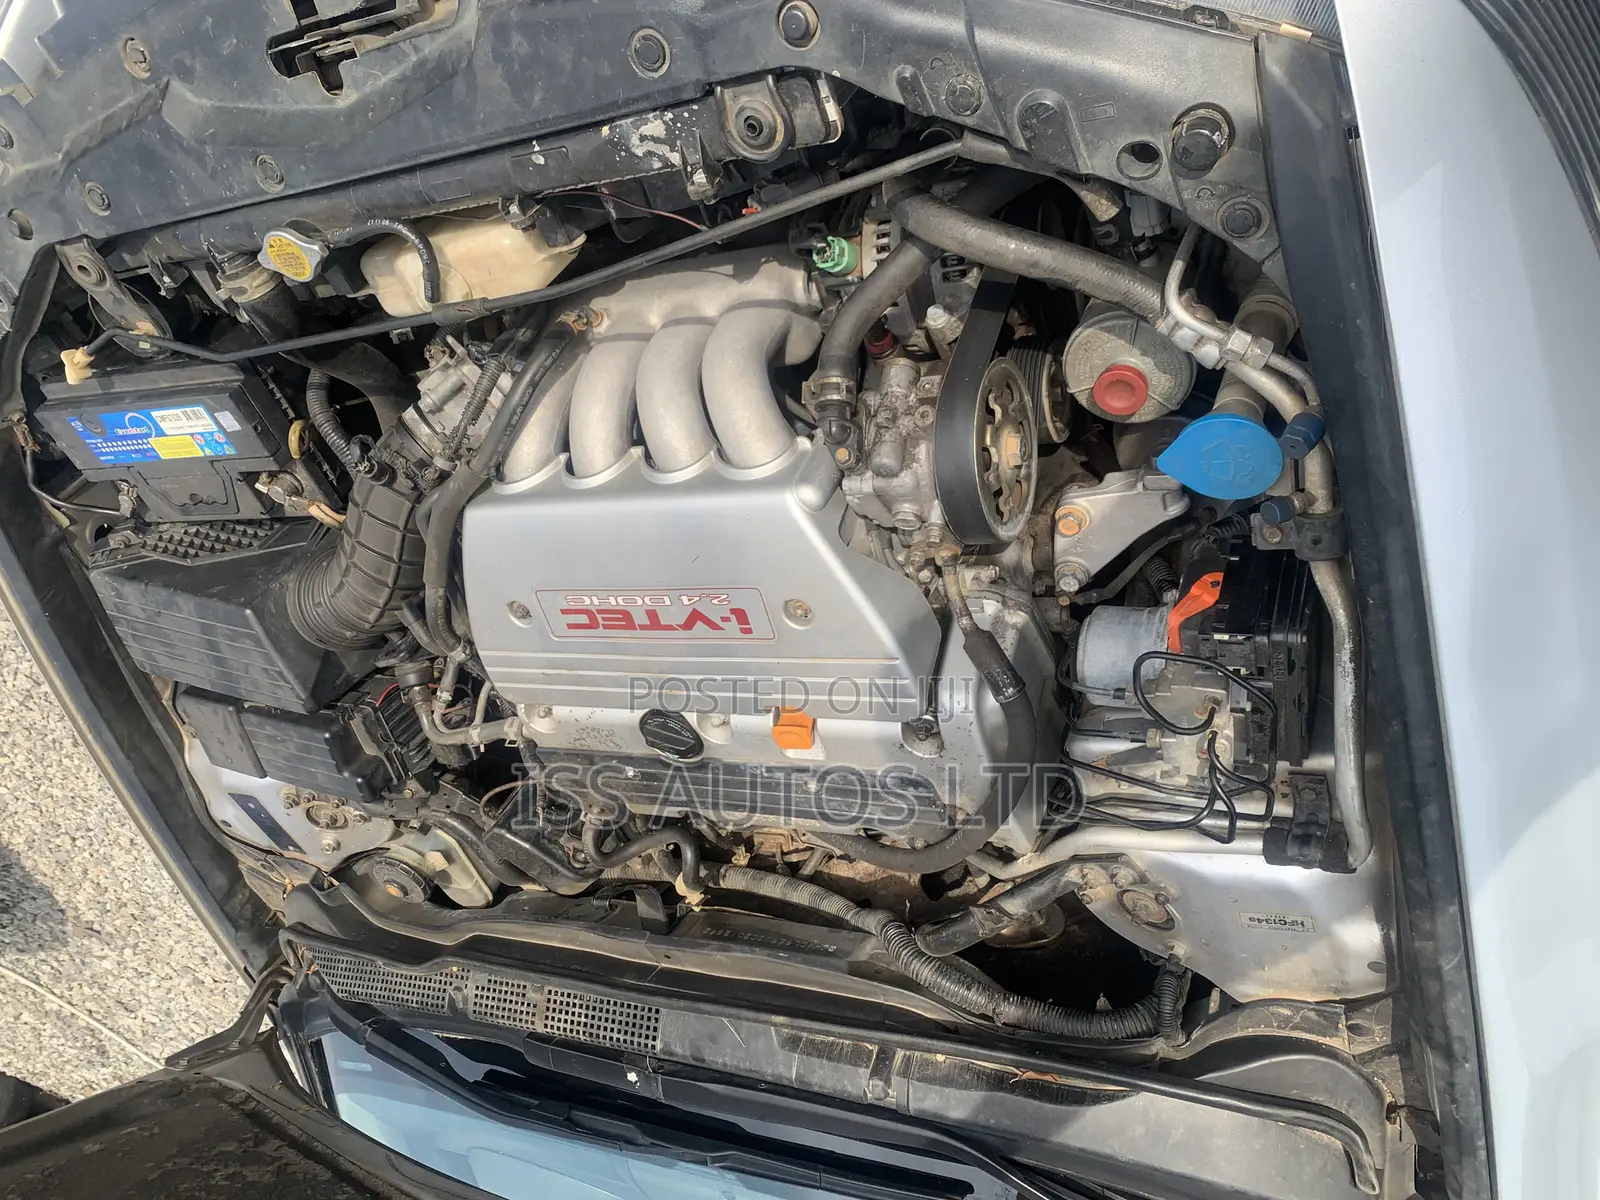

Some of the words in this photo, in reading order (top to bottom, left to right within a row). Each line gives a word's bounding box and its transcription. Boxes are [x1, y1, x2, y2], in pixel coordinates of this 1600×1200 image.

[564, 594, 673, 607] DOHC
[678, 592, 732, 606] 2.4
[559, 607, 754, 635] i-VTEC
[1248, 917, 1304, 927] HFC134a
